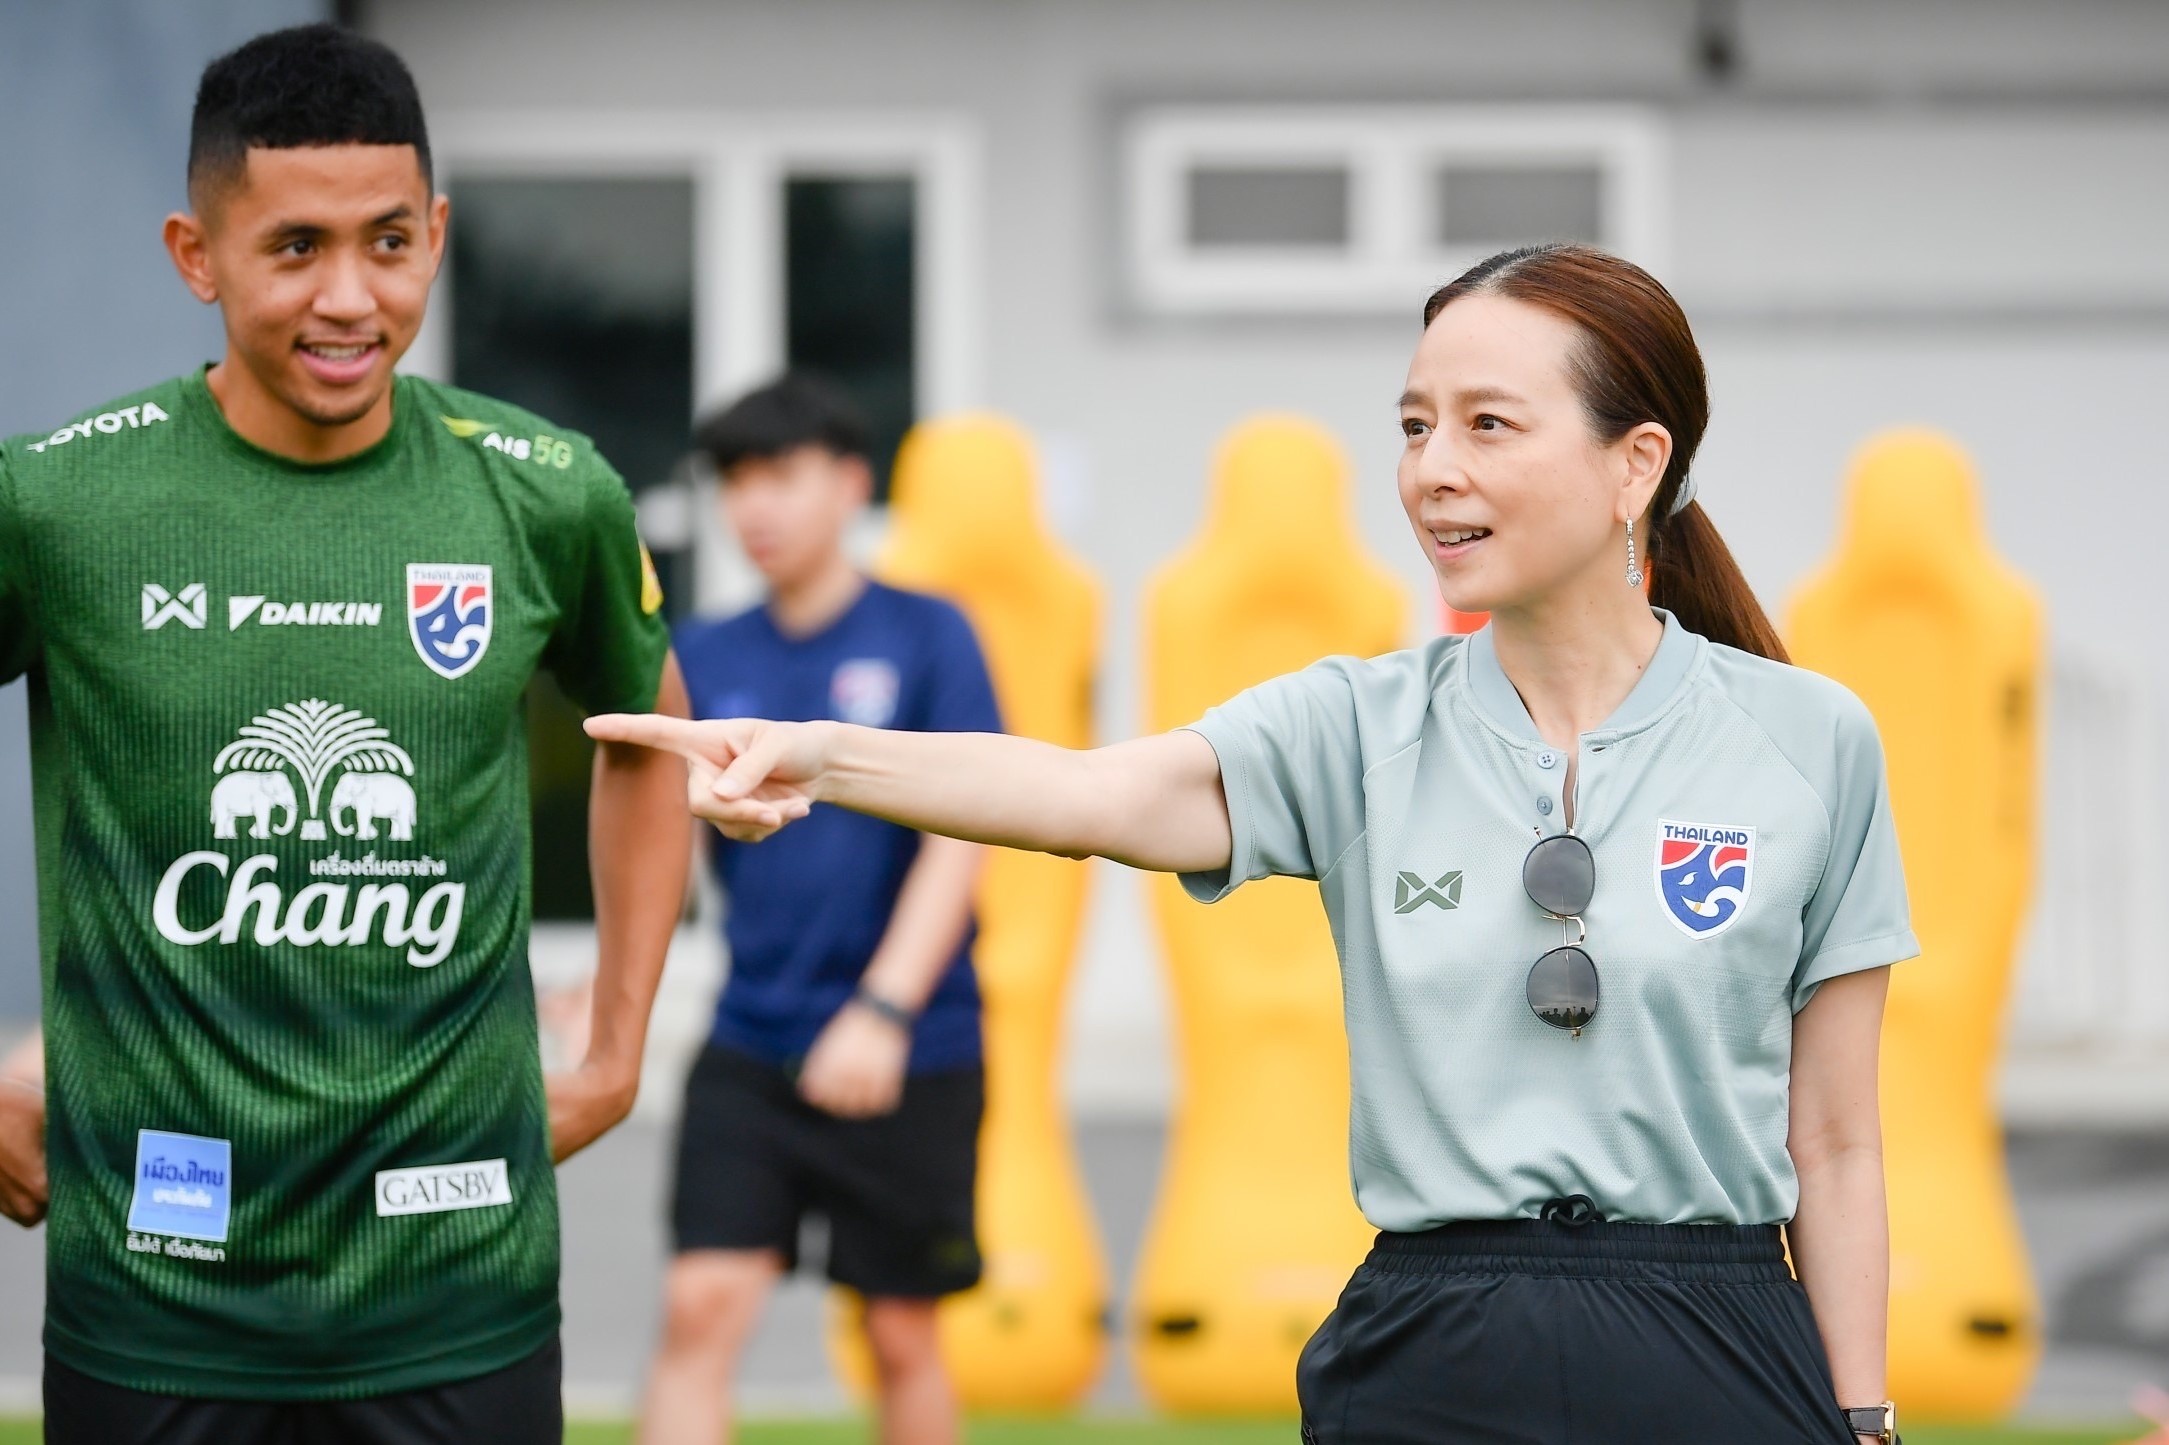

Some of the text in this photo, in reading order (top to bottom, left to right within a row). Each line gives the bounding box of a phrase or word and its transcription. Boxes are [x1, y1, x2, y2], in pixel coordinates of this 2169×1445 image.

[26, 401, 170, 453] TOYOTA
[482, 432, 573, 469] AIS 5G
[259, 602, 383, 626] DAIKIN
[1664, 825, 1749, 846] THAILAND
[152, 850, 466, 969] Chang
[143, 1156, 225, 1188] เมืองไทย
[383, 1166, 500, 1208] GATSBY
